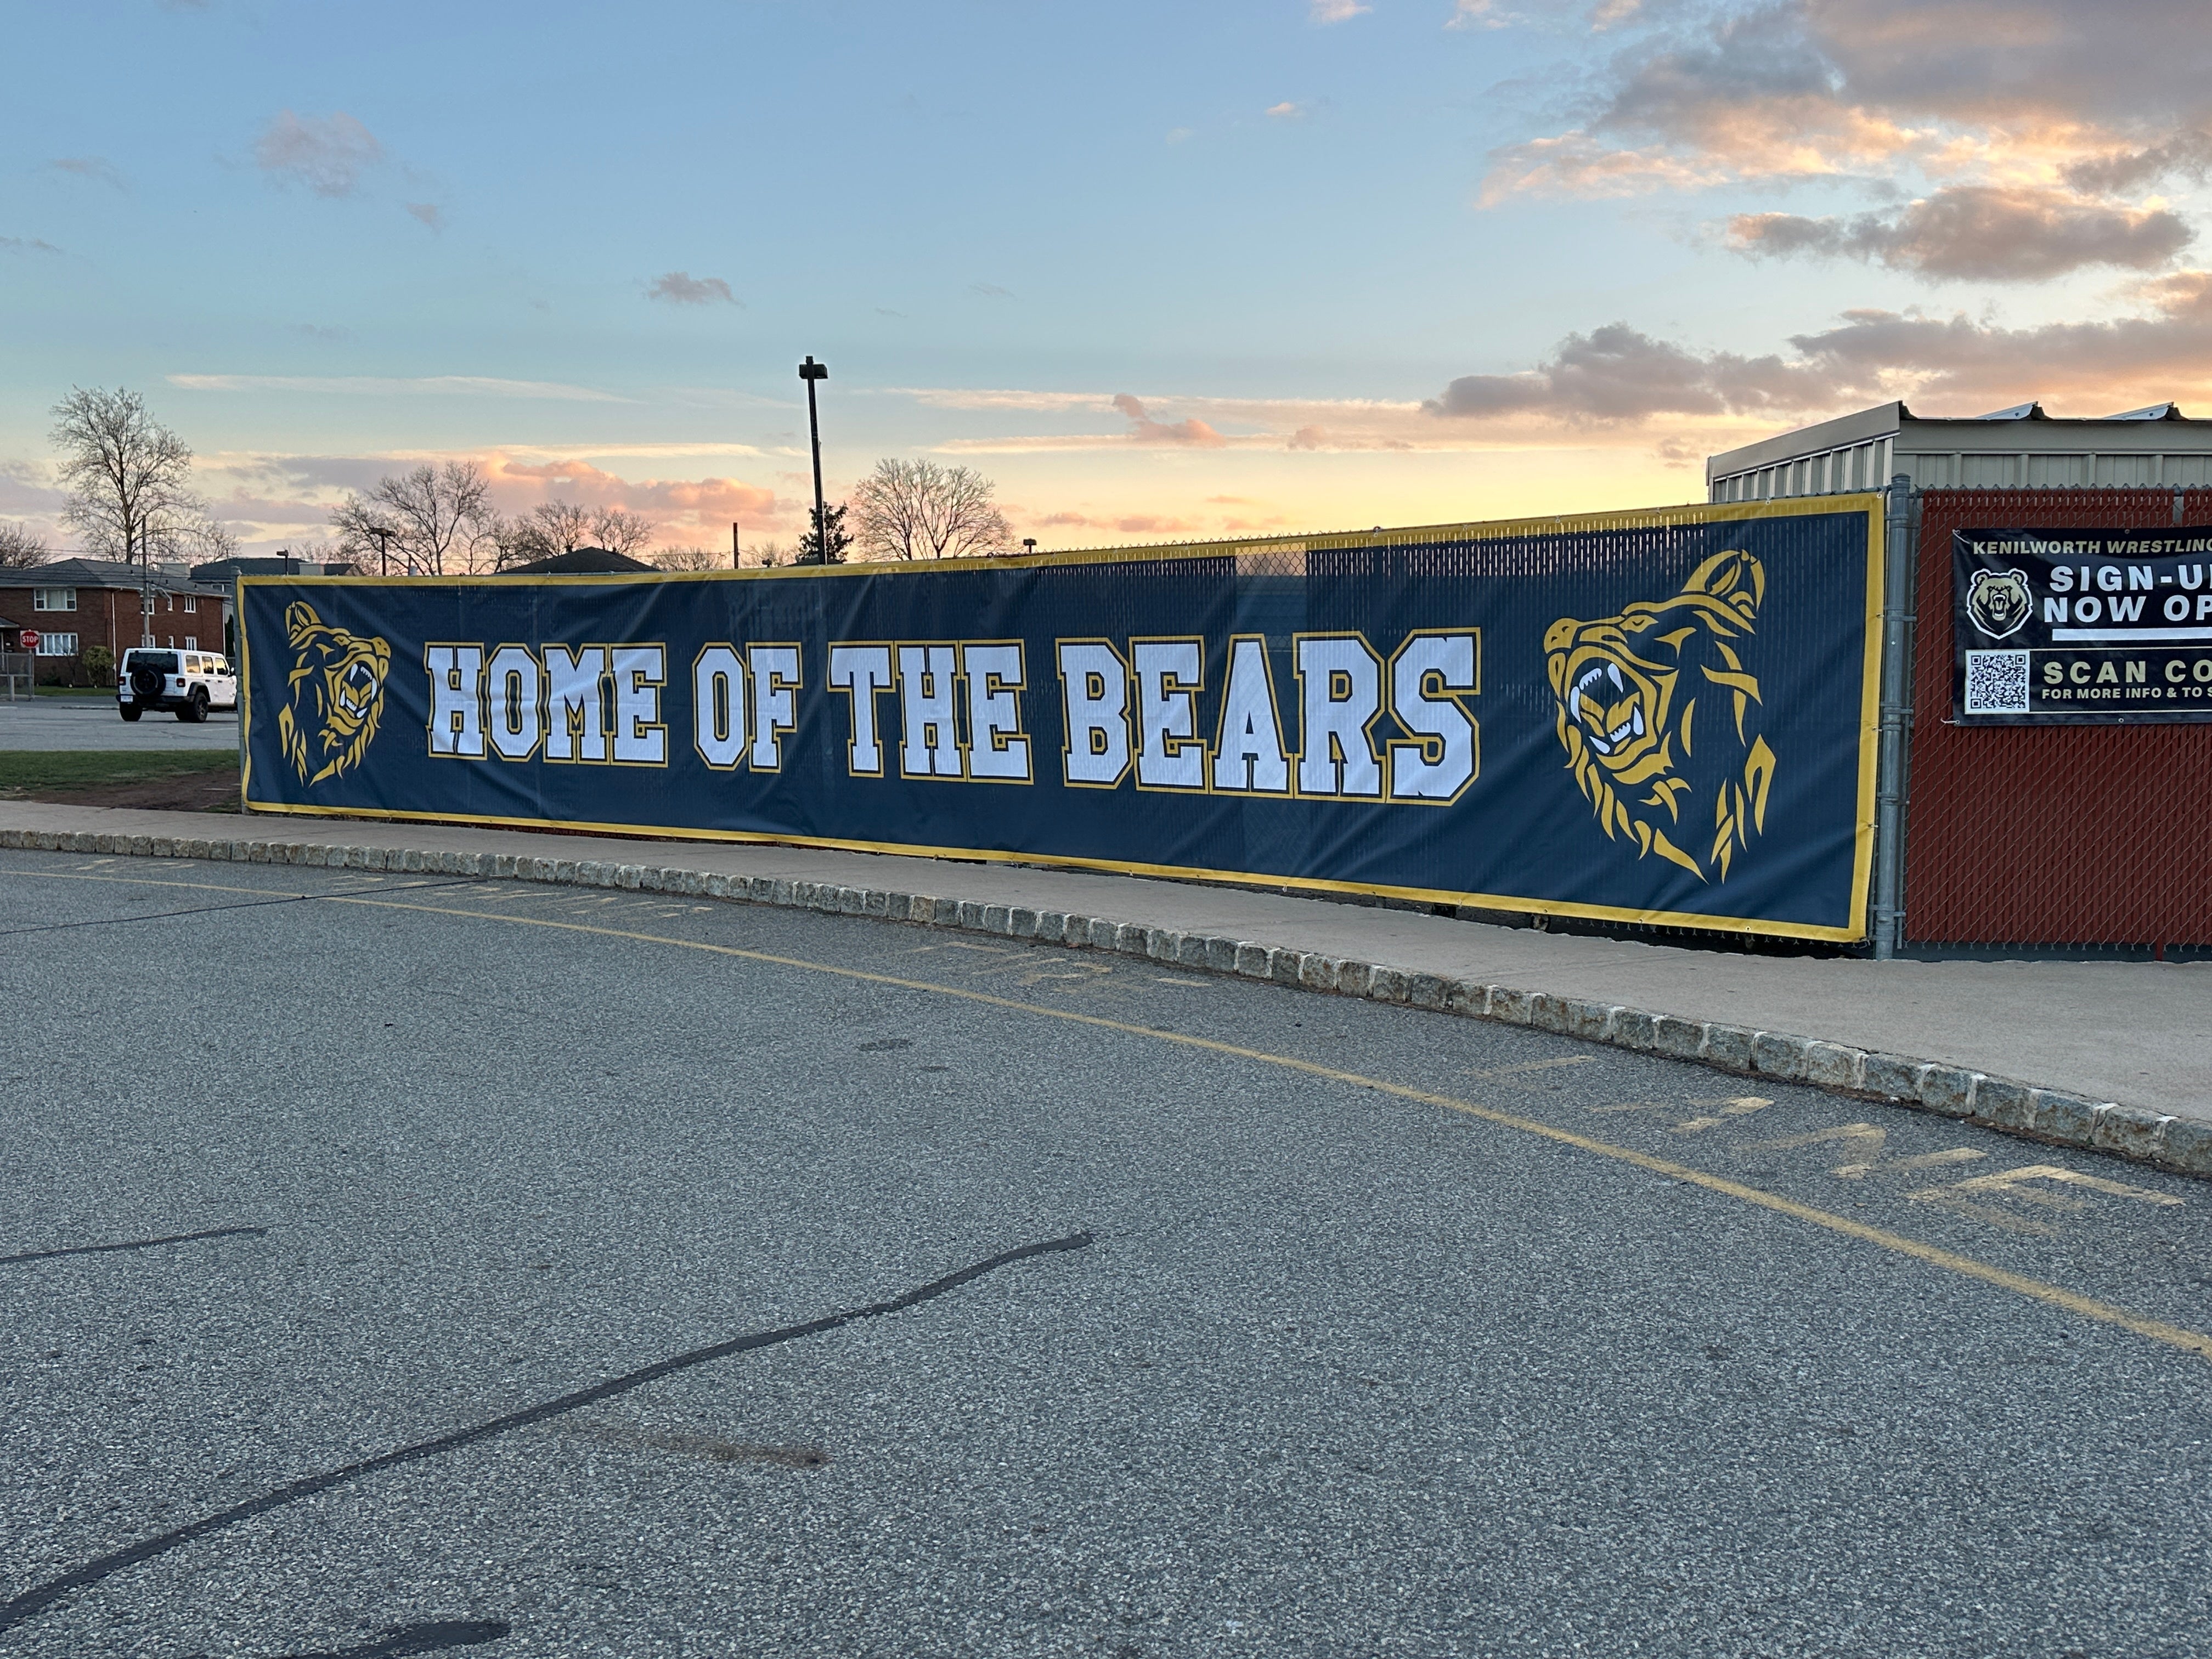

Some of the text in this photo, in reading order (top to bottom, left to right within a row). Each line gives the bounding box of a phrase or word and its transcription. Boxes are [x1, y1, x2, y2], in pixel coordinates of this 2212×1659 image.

[1973, 540, 2101, 554] KENILWORTH
[2050, 564, 2212, 592] SIGN-U
[2044, 596, 2146, 623] NOW
[2044, 661, 2146, 684] SCAN
[2042, 689, 2072, 699] FOR
[2076, 688, 2120, 699] MORE
[2126, 687, 2162, 698] INFO
[2166, 687, 2177, 698] &
[2182, 686, 2202, 697] TO
[424, 627, 1481, 806] HOME OF THE BEARS
